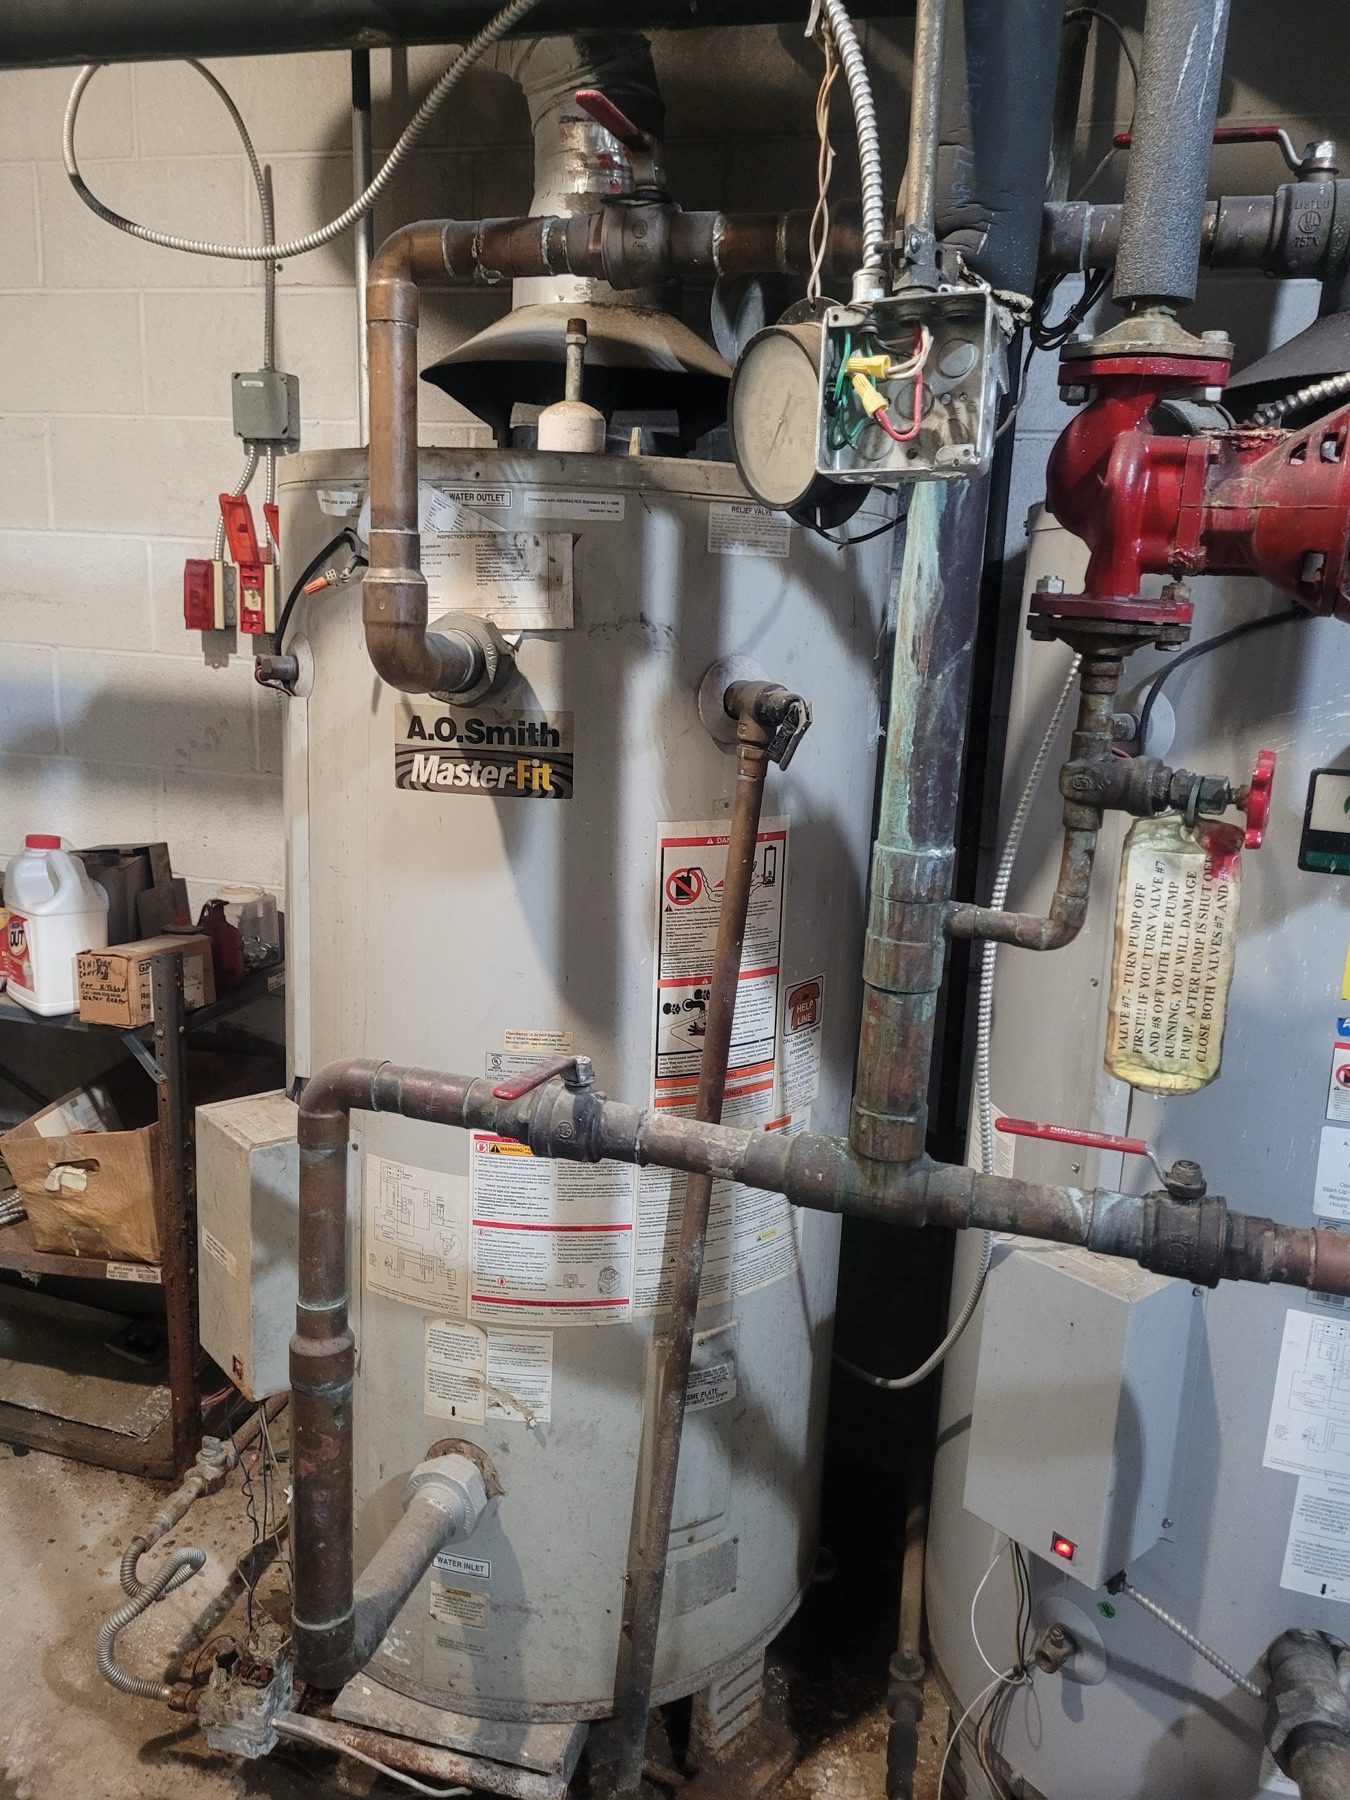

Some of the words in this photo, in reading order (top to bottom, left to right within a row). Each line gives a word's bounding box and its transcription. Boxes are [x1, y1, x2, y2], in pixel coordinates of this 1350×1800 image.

[448, 491, 475, 502] WATER
[476, 493, 506, 504] OUTLET
[730, 505, 754, 515] RELIEF
[753, 508, 774, 517] VALVE
[410, 753, 555, 792] Master-Fit
[715, 836, 731, 846] DAN
[1154, 860, 1166, 875] #7
[1133, 882, 1147, 910] OFF
[1147, 876, 1164, 922] VALVE
[1165, 881, 1180, 920] PUMP
[1179, 870, 1198, 930] DAMAGE
[1198, 883, 1213, 921] SHUT
[1217, 883, 1230, 914] AND
[1128, 910, 1143, 949] PUMP
[1161, 920, 1175, 949] THE
[1196, 919, 1208, 936] IS
[1214, 914, 1226, 930] #7
[10, 930, 25, 947] OUT
[1142, 923, 1157, 960] TURN
[1175, 930, 1191, 967] WILL
[1124, 950, 1138, 987] TURN
[1156, 949, 1171, 988] WITH
[1190, 936, 1206, 976] PUMP
[1206, 930, 1224, 983] VALVES
[1140, 962, 1153, 990] YOU
[1171, 968, 1186, 996] YOU
[796, 1000, 815, 1014] HELP
[1121, 995, 1133, 1010] #7
[1138, 992, 1150, 1005] IF
[1152, 988, 1166, 1014] OFF
[1186, 976, 1202, 1020] AFTER
[1201, 984, 1217, 1022] BOTH
[797, 1013, 813, 1026] LINE
[1118, 1011, 1131, 1051] VALVE
[1132, 1007, 1148, 1055] FIRST!!!
[1151, 1015, 1163, 1030] #8
[1164, 999, 1182, 1059] RUNNING,
[1149, 1030, 1161, 1057] AND
[1180, 1024, 1194, 1060] PUMP.
[1195, 1022, 1212, 1063] CLOSE
[1322, 1186, 1348, 1195] Start-Up
[686, 1392, 700, 1401] SME
[700, 1387, 719, 1398] PLATE
[436, 1555, 462, 1569] WATER
[463, 1562, 485, 1573] INLET
